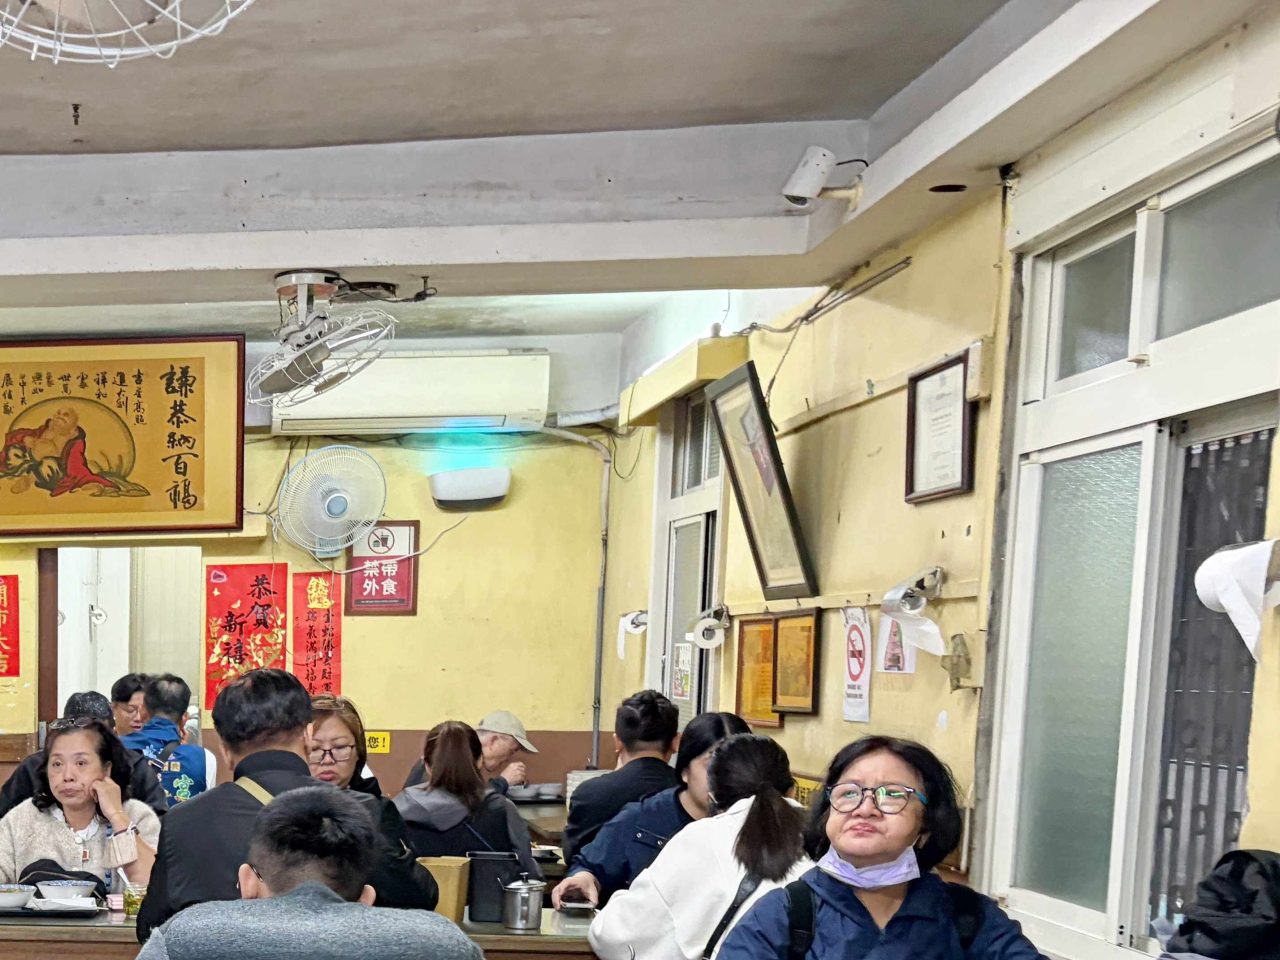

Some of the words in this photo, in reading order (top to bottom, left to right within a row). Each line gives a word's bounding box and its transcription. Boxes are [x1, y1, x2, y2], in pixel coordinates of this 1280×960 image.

[159, 364, 199, 510] 謙恭納百福
[246, 573, 278, 629] 恭賀
[362, 578, 398, 597] 外食
[221, 610, 249, 665] 新禧
